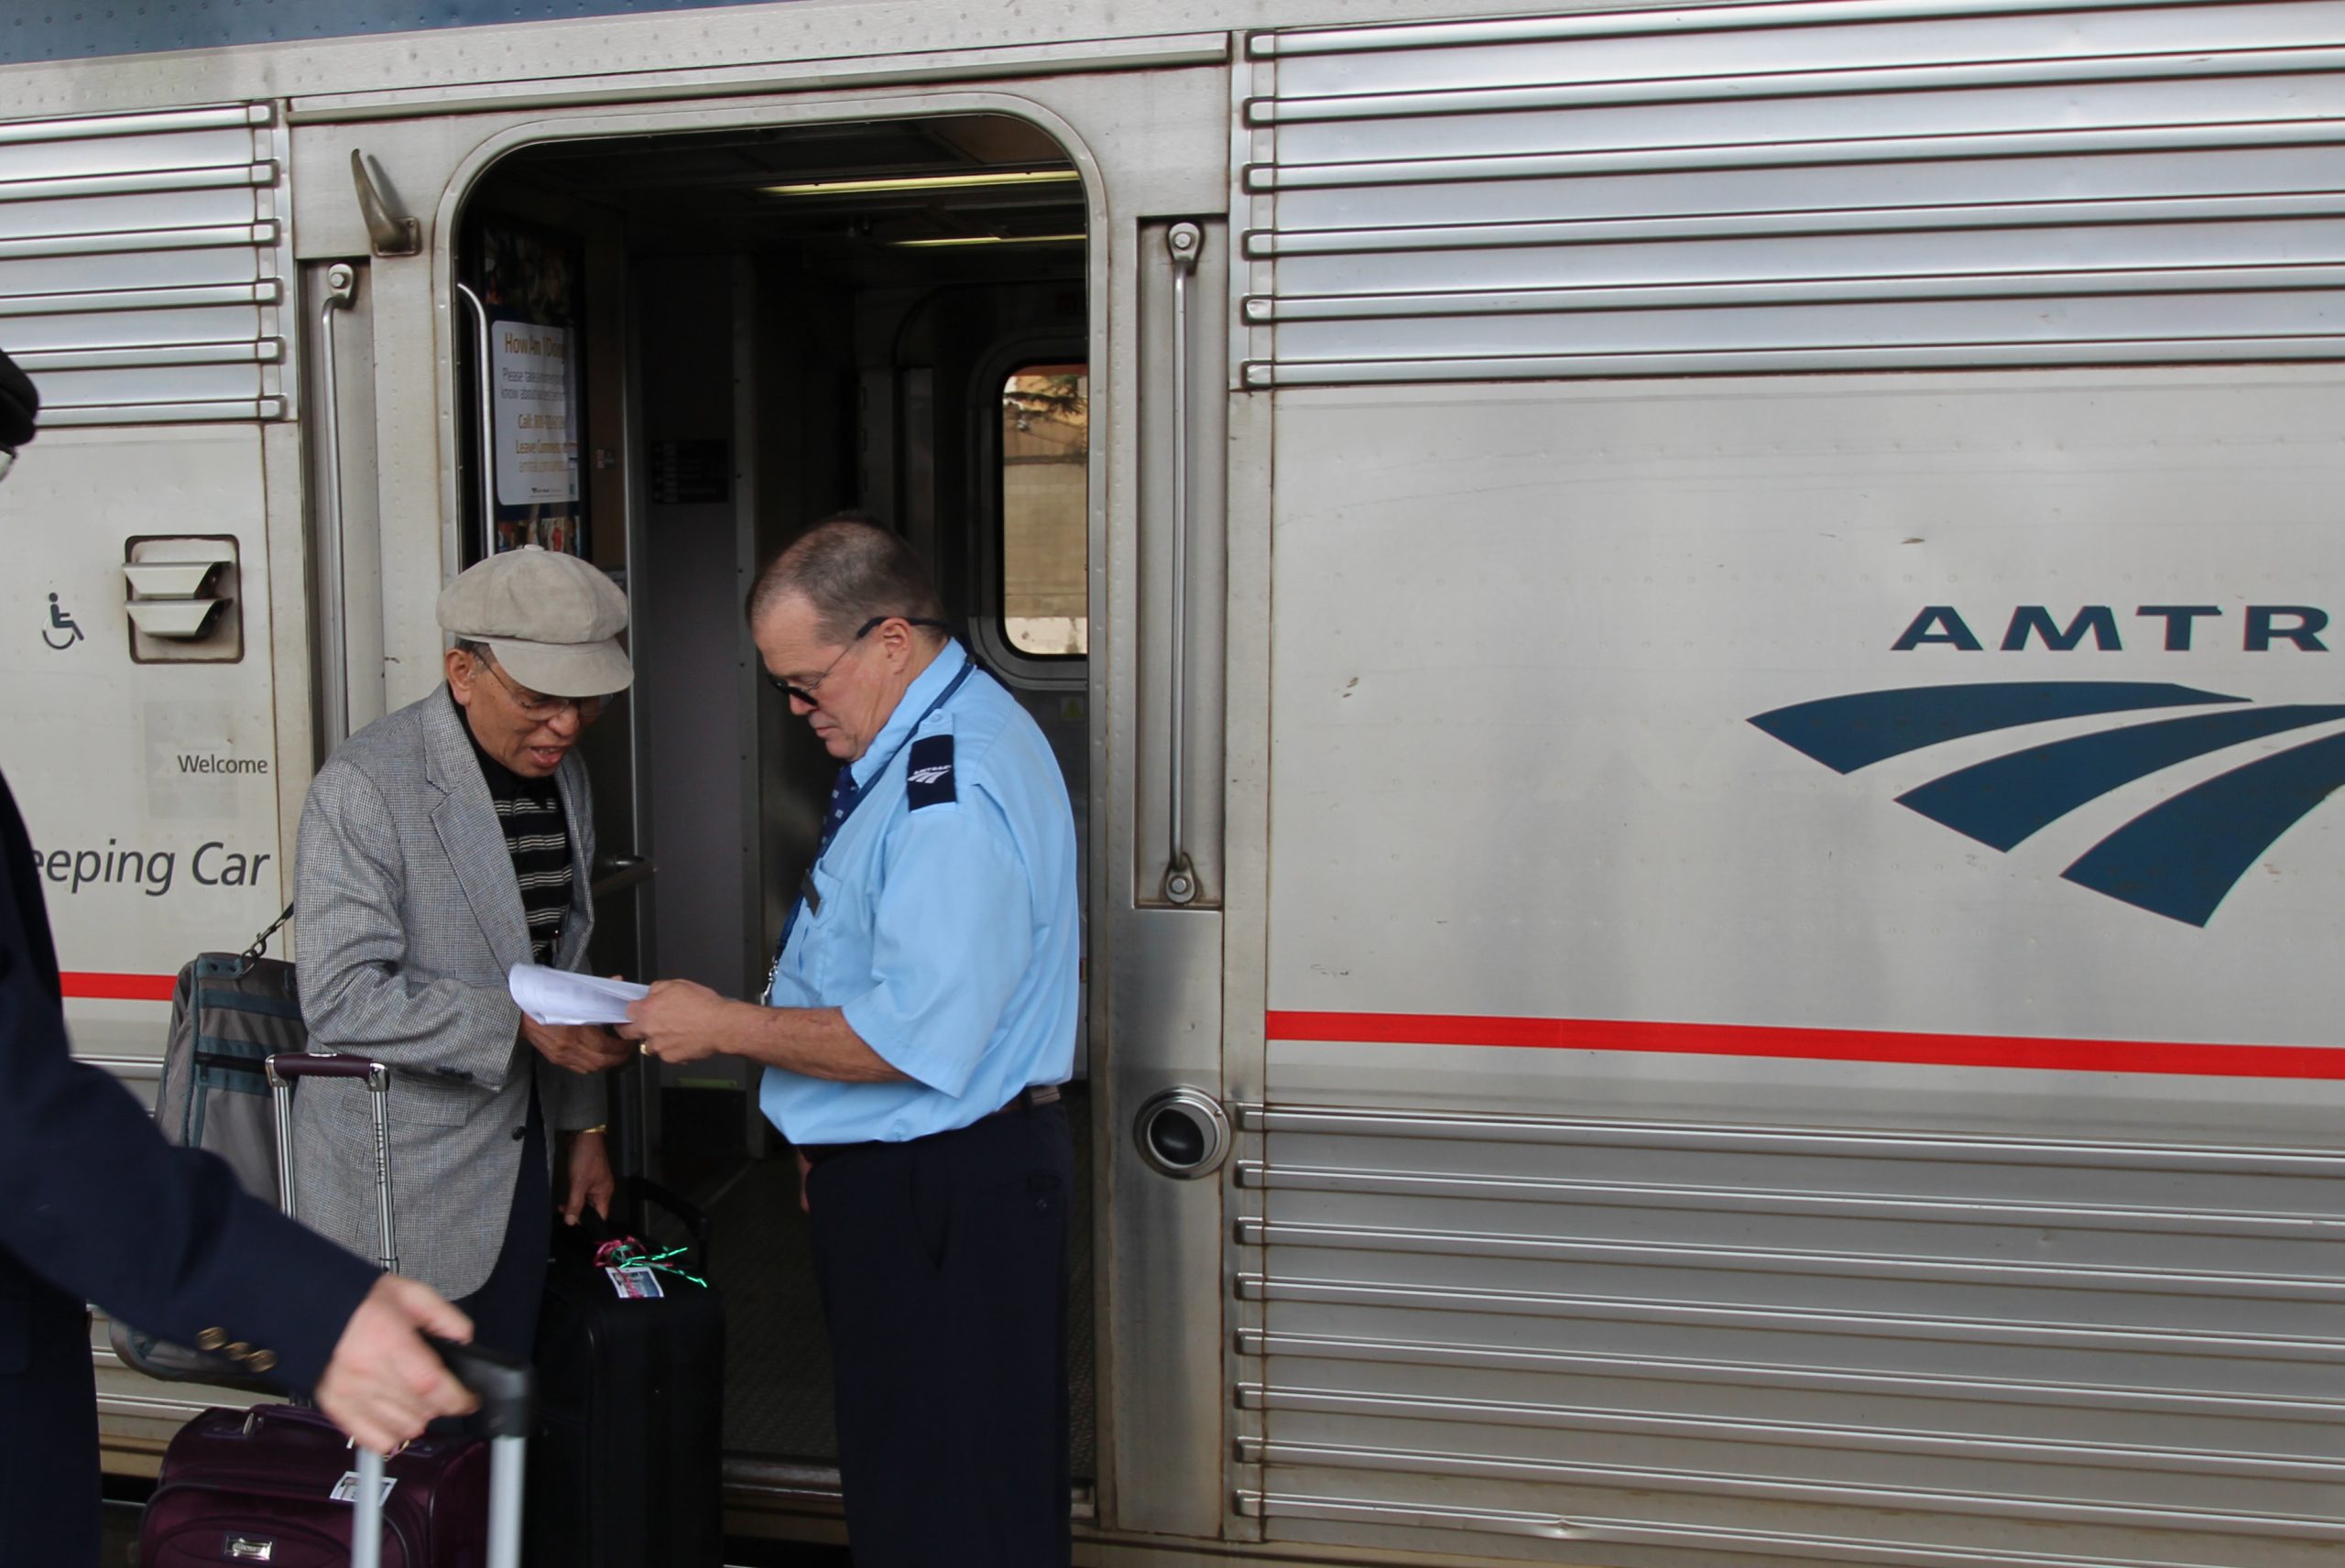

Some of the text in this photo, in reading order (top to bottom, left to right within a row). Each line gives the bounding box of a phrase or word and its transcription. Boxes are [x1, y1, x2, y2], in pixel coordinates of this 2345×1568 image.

[505, 332, 529, 354] How
[503, 366, 524, 383] Please
[516, 439, 537, 454] Leave
[1890, 605, 2329, 652] AMTR
[178, 754, 268, 774] Welcome
[191, 842, 270, 886] Car
